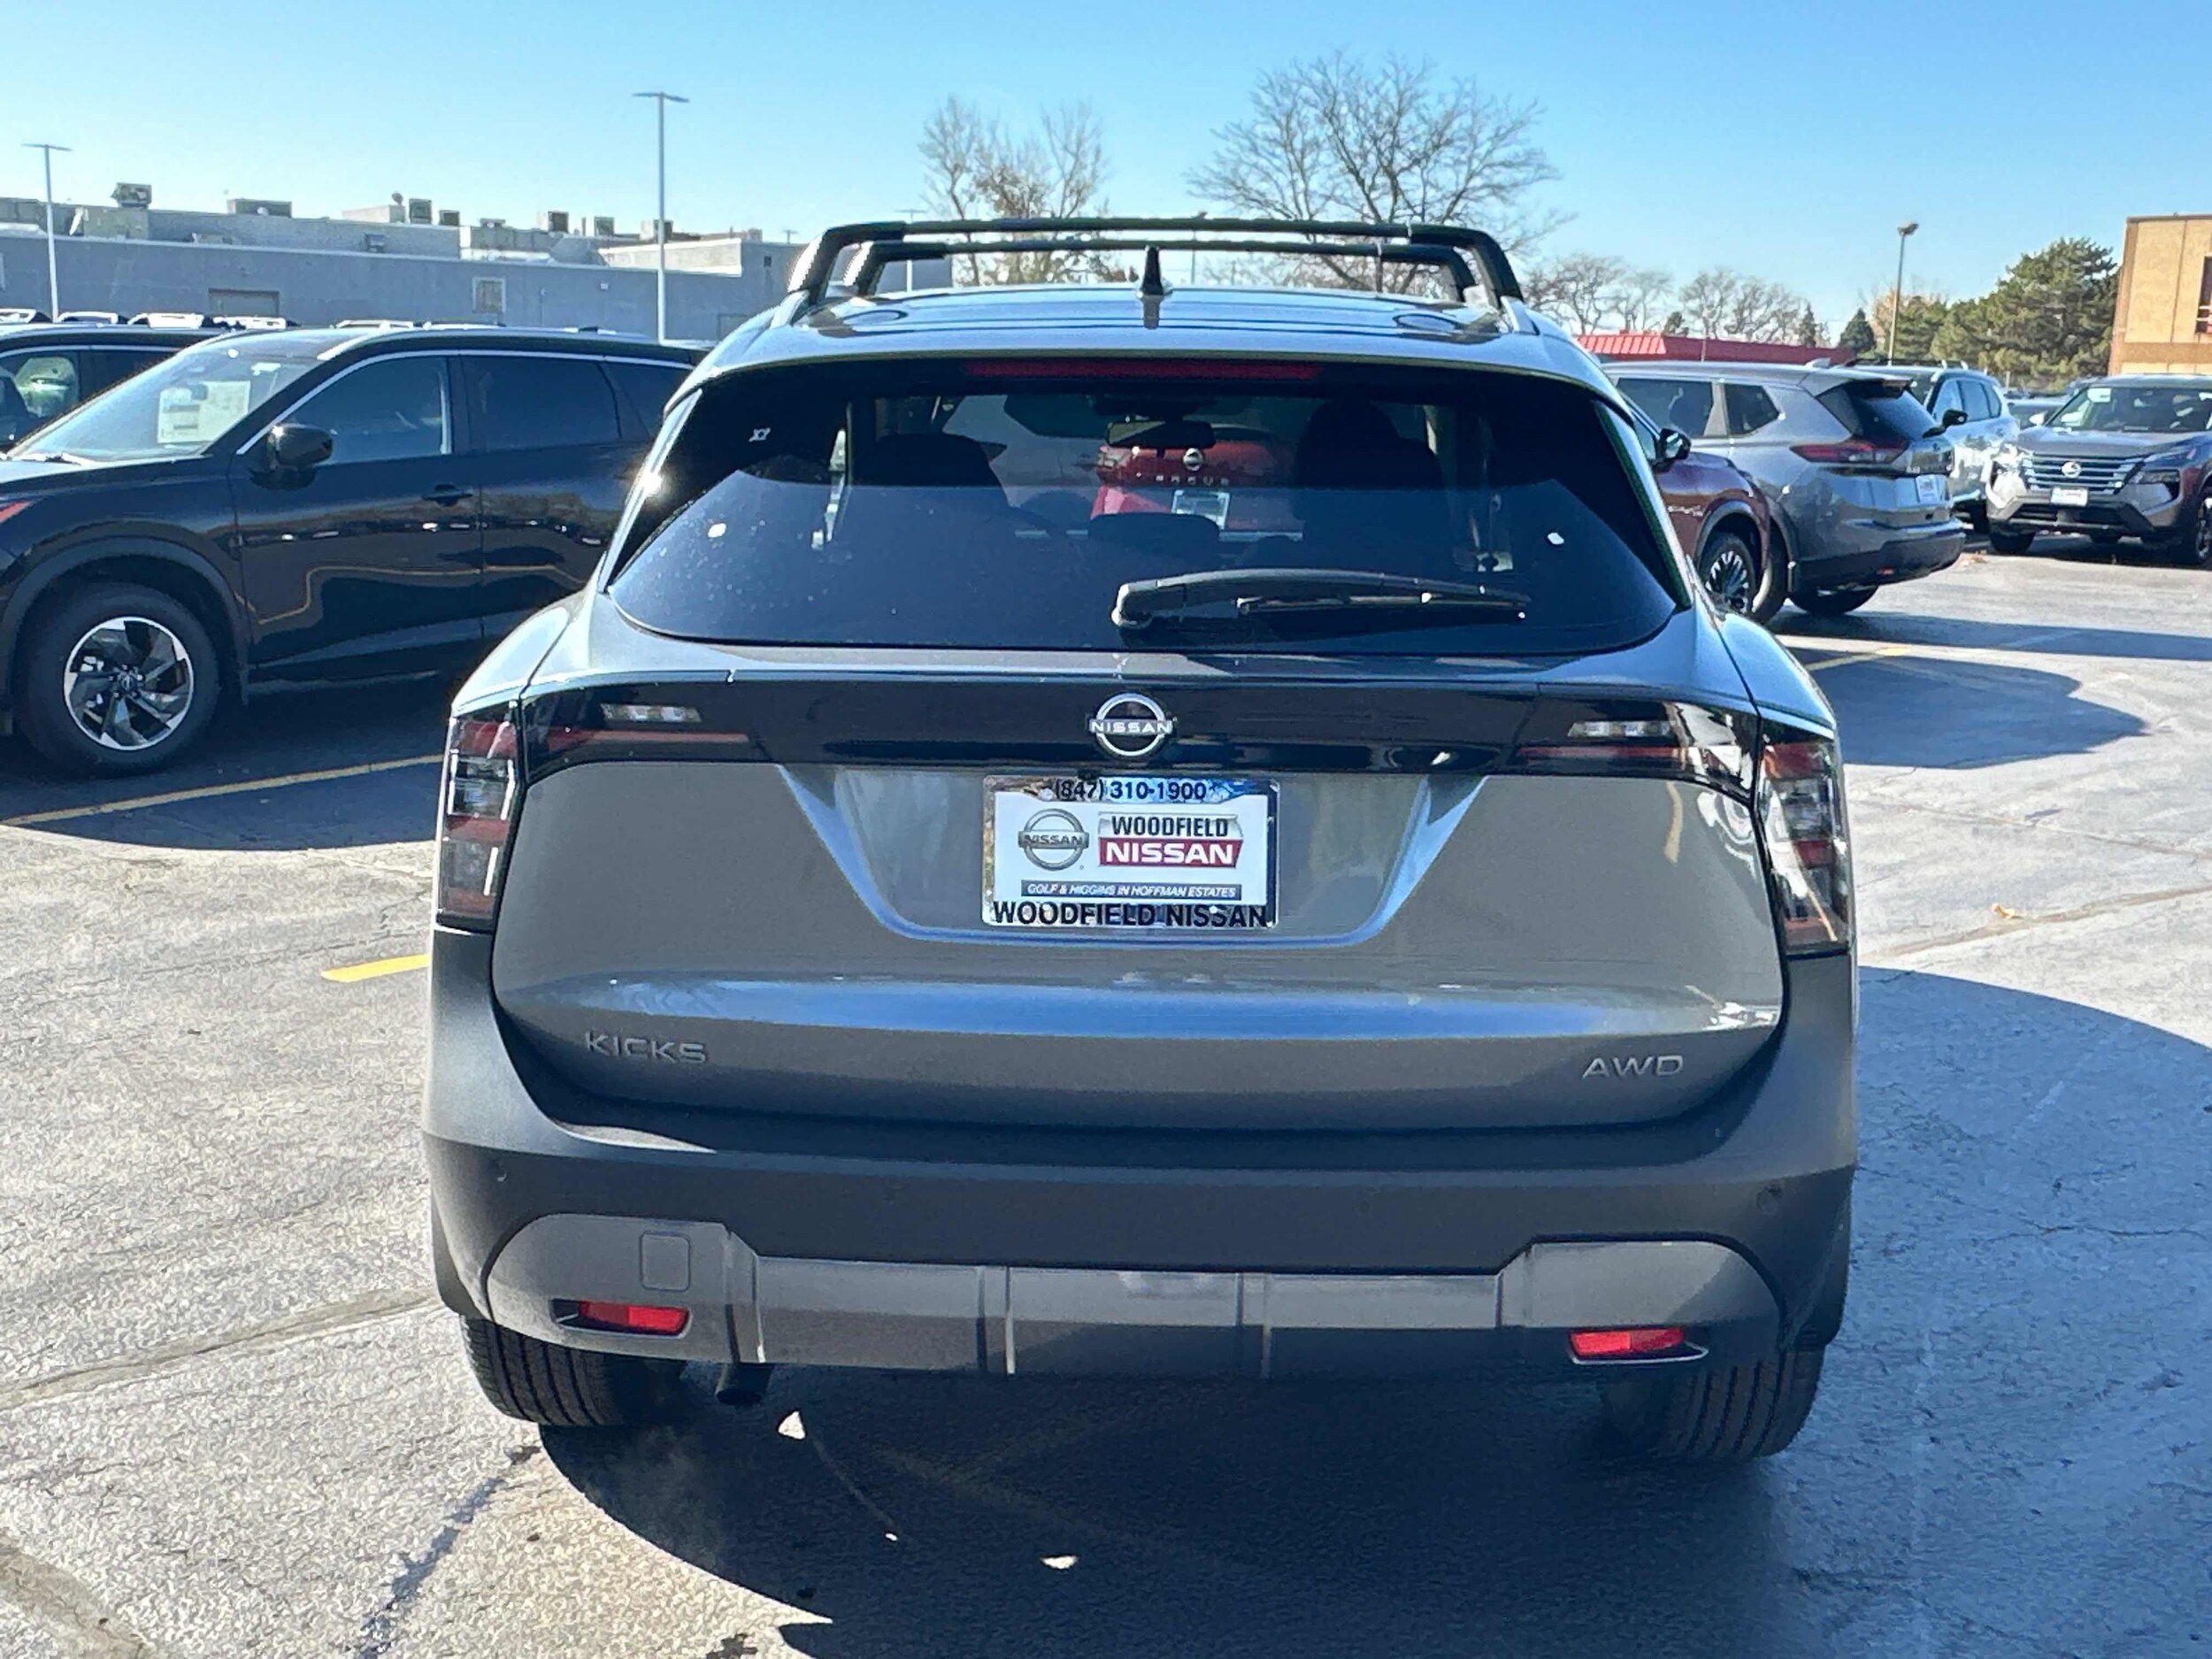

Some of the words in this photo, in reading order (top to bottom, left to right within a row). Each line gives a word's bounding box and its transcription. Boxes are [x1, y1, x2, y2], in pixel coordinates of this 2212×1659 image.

[1091, 721, 1170, 733] NISSAN
[1056, 779, 1104, 801] (847)
[1110, 780, 1207, 800] 310-1900
[1111, 815, 1229, 837] WOODFIELD
[1024, 834, 1083, 846] NISSAN
[1106, 842, 1233, 864] NISSAN
[1027, 883, 1057, 895] GOLF
[1059, 884, 1068, 895] &
[1131, 886, 1187, 897] HOFFMAN
[1187, 886, 1237, 898] ESTATES
[993, 901, 1156, 926] WOODFIELD
[1165, 903, 1268, 927] NISSAN
[585, 1031, 707, 1063] KICKS
[1582, 1055, 1684, 1079] AWD
